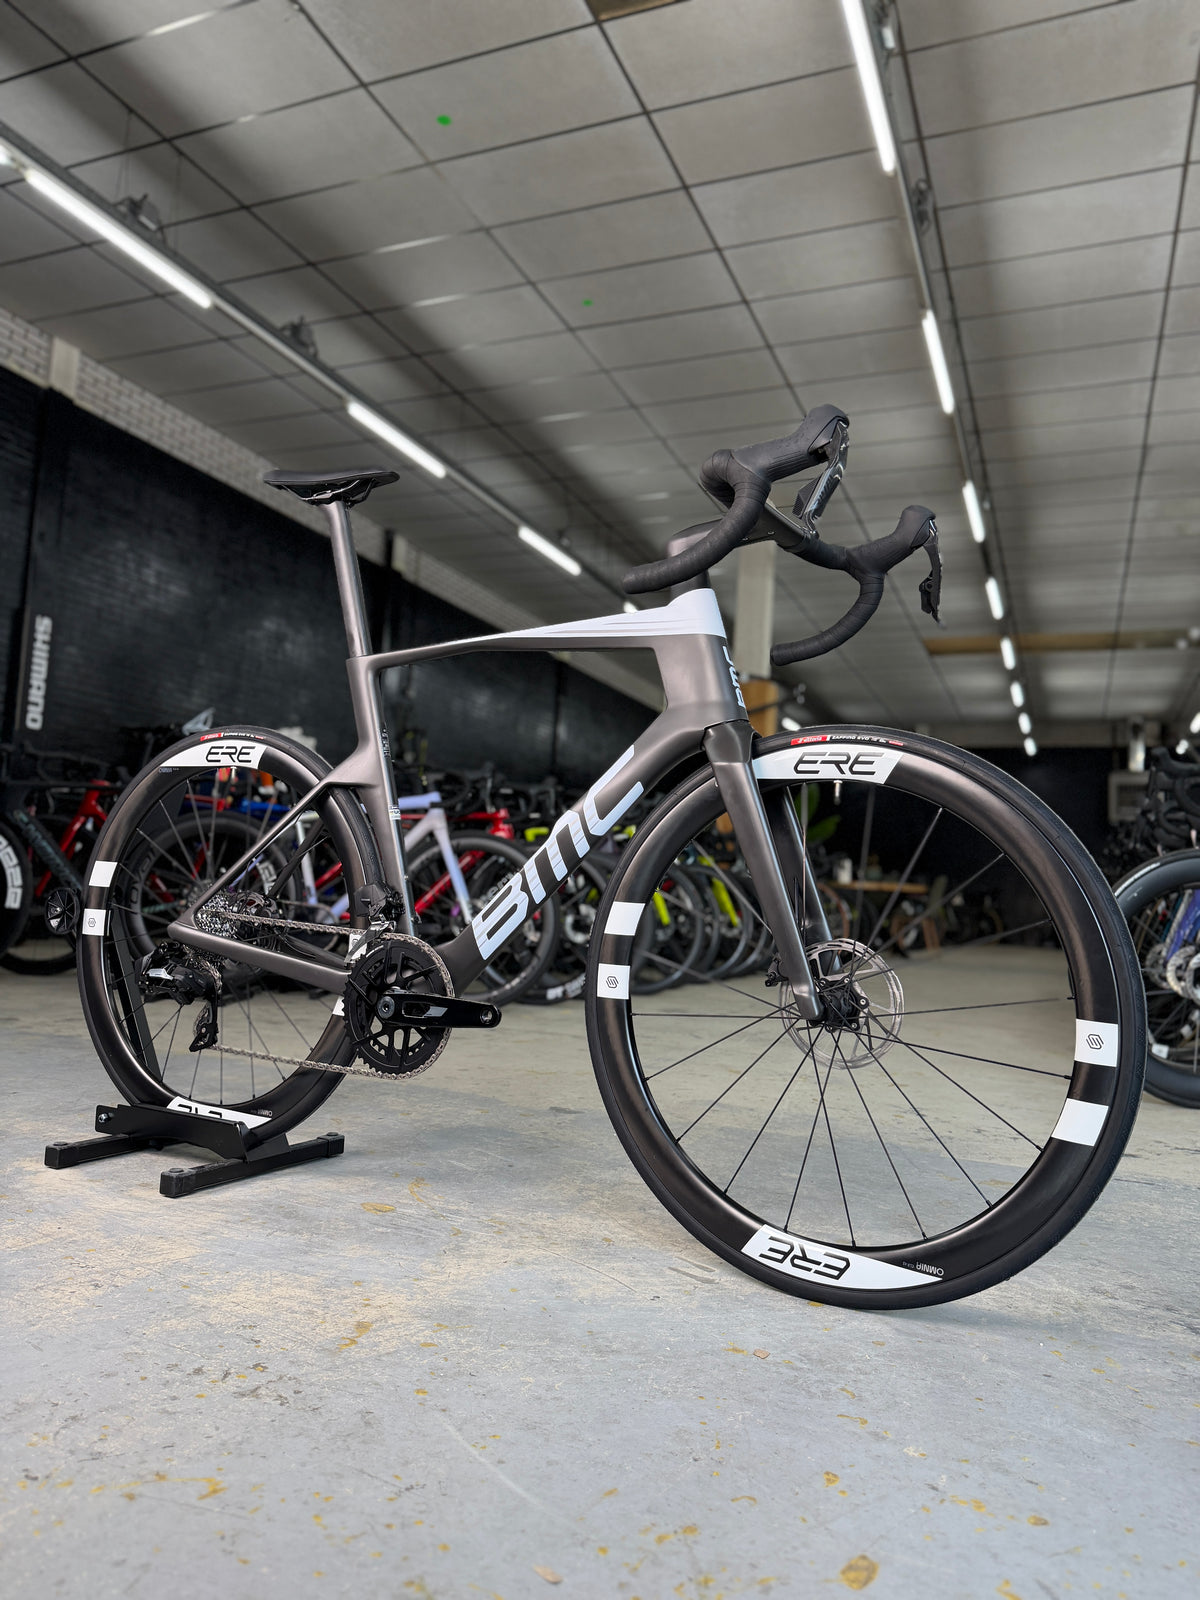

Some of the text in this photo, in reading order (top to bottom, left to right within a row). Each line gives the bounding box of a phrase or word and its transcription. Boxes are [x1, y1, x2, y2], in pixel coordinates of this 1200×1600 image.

[26, 615, 53, 731] SHIMANO
[205, 746, 256, 763] ERE
[793, 751, 885, 776] ERE
[759, 1236, 851, 1280] ERE
[915, 1261, 945, 1277] OMNIA
